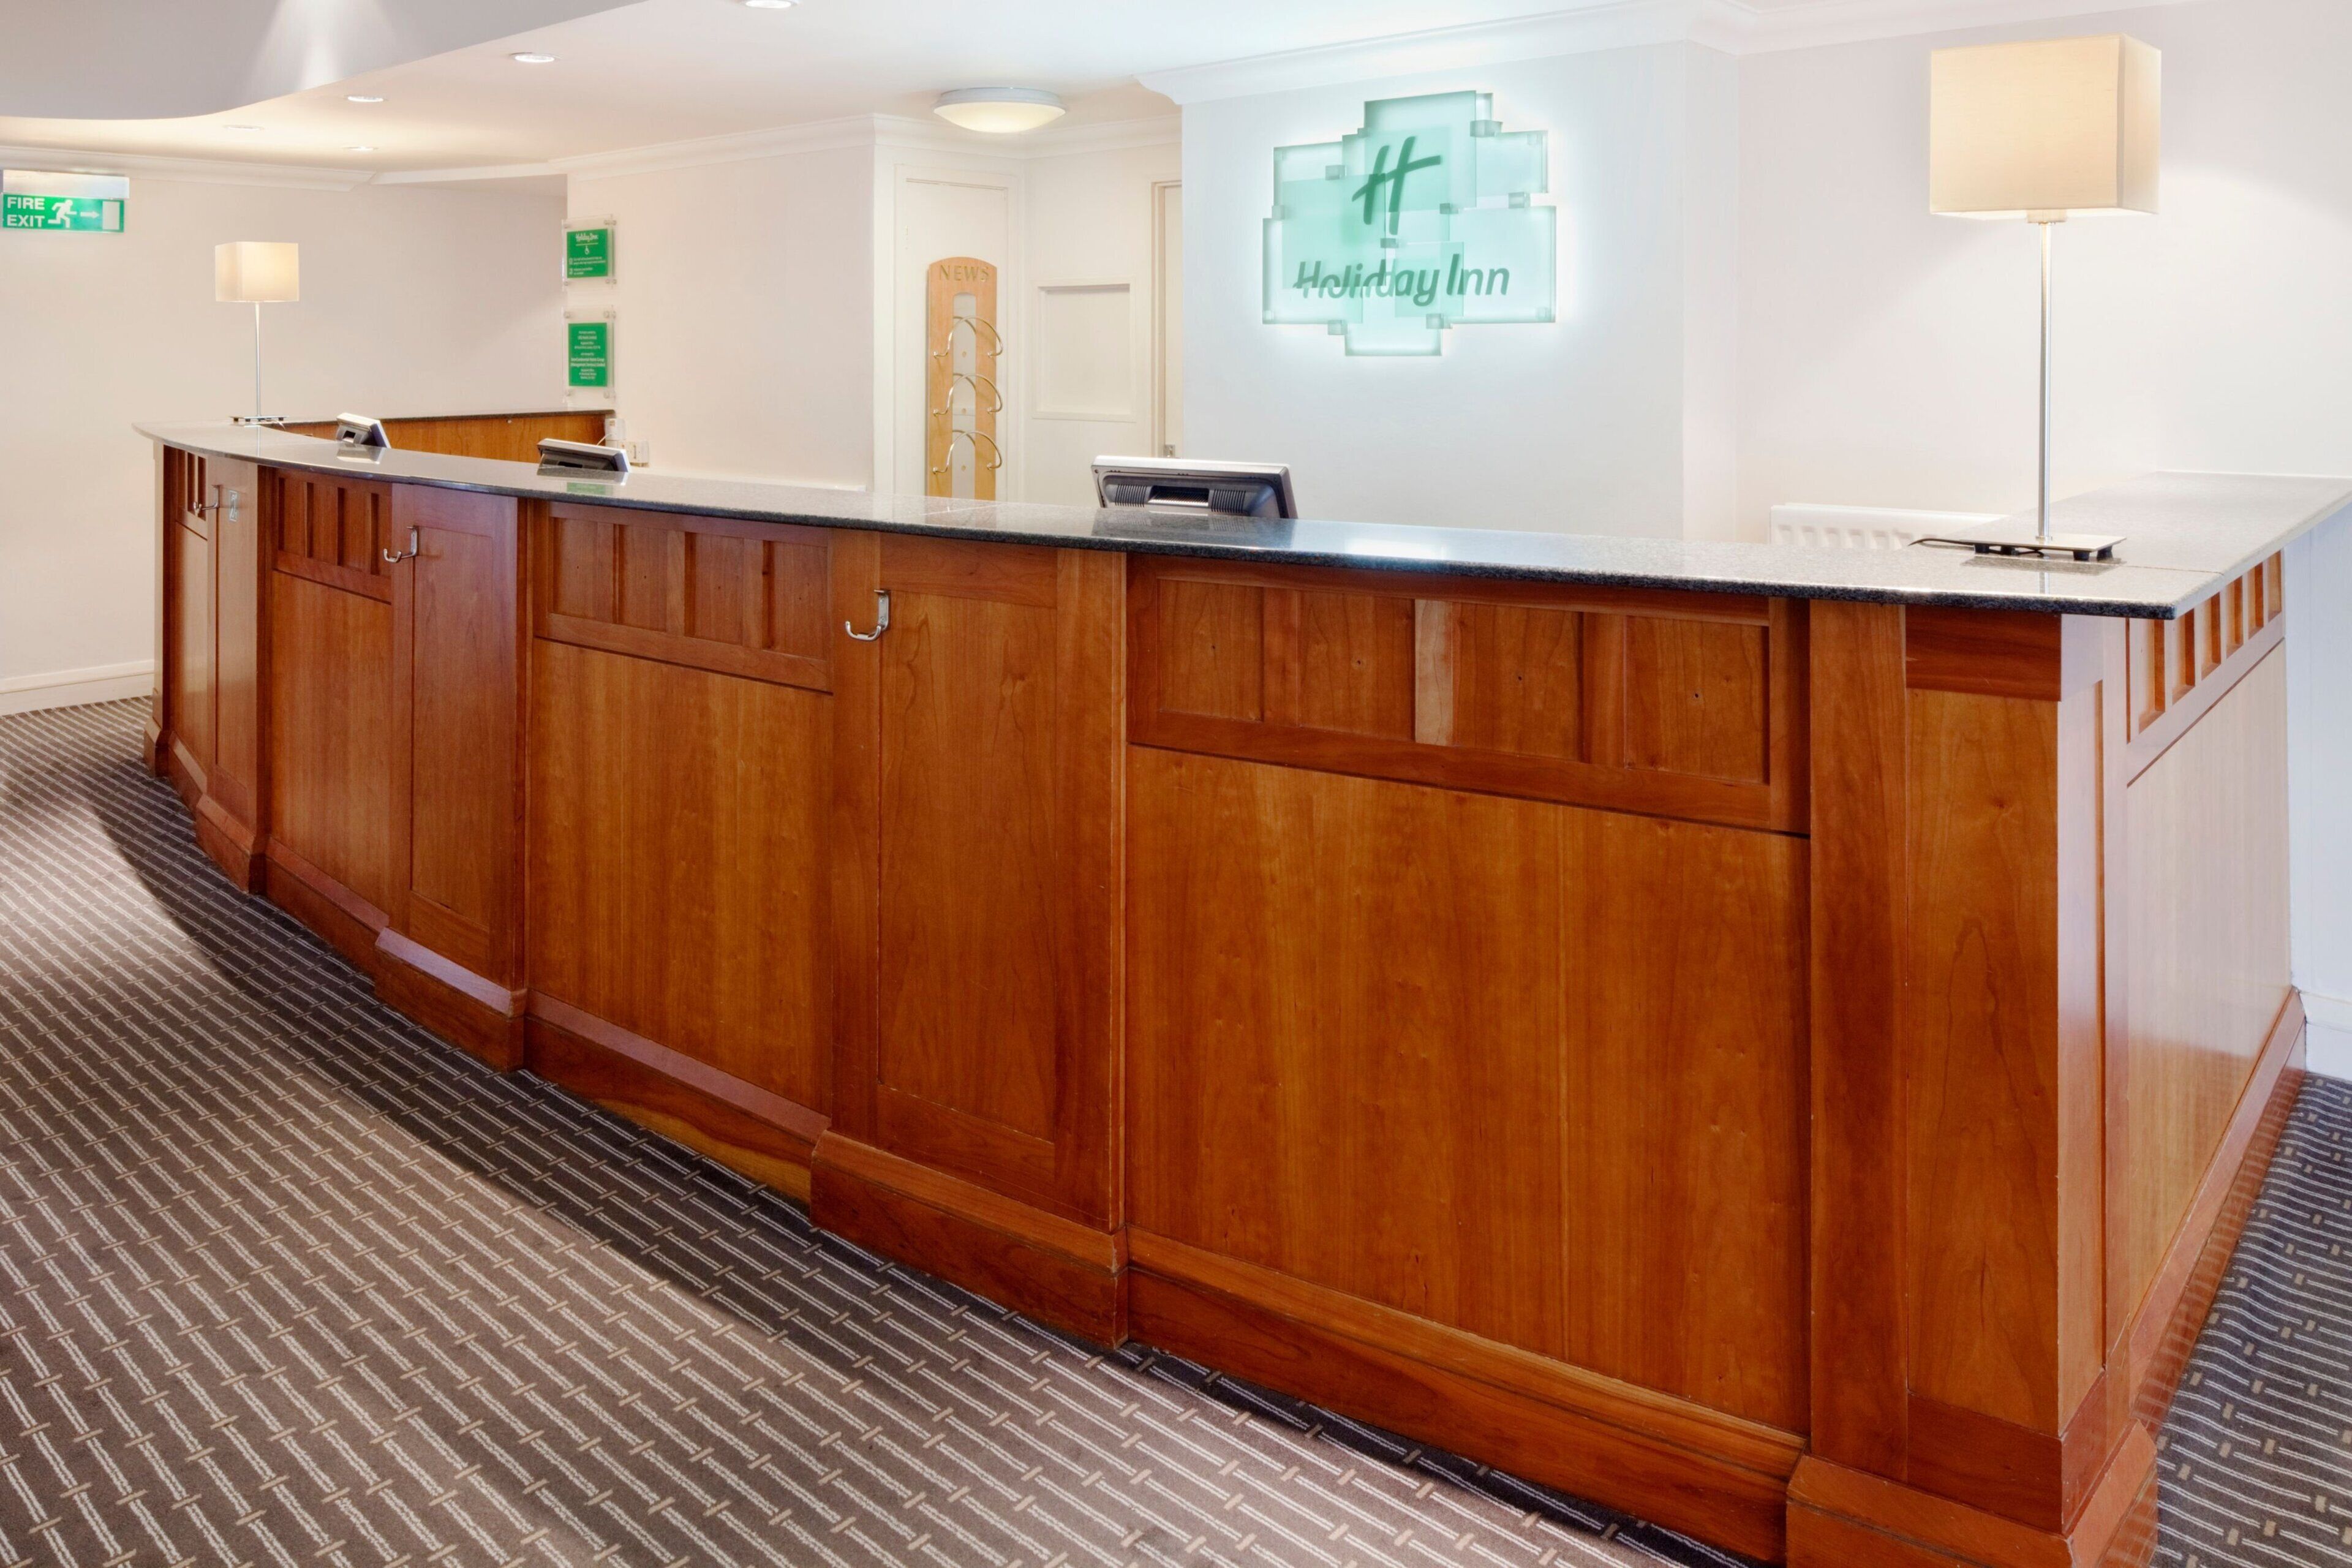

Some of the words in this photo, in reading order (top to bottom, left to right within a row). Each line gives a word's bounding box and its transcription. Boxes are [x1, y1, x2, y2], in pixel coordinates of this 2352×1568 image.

[1352, 136, 1441, 235] H
[7, 197, 45, 210] FIRE
[7, 214, 45, 227] EXIT
[940, 265, 989, 282] NEWS
[1293, 258, 1440, 306] Holiday
[1446, 254, 1510, 296] Inn
